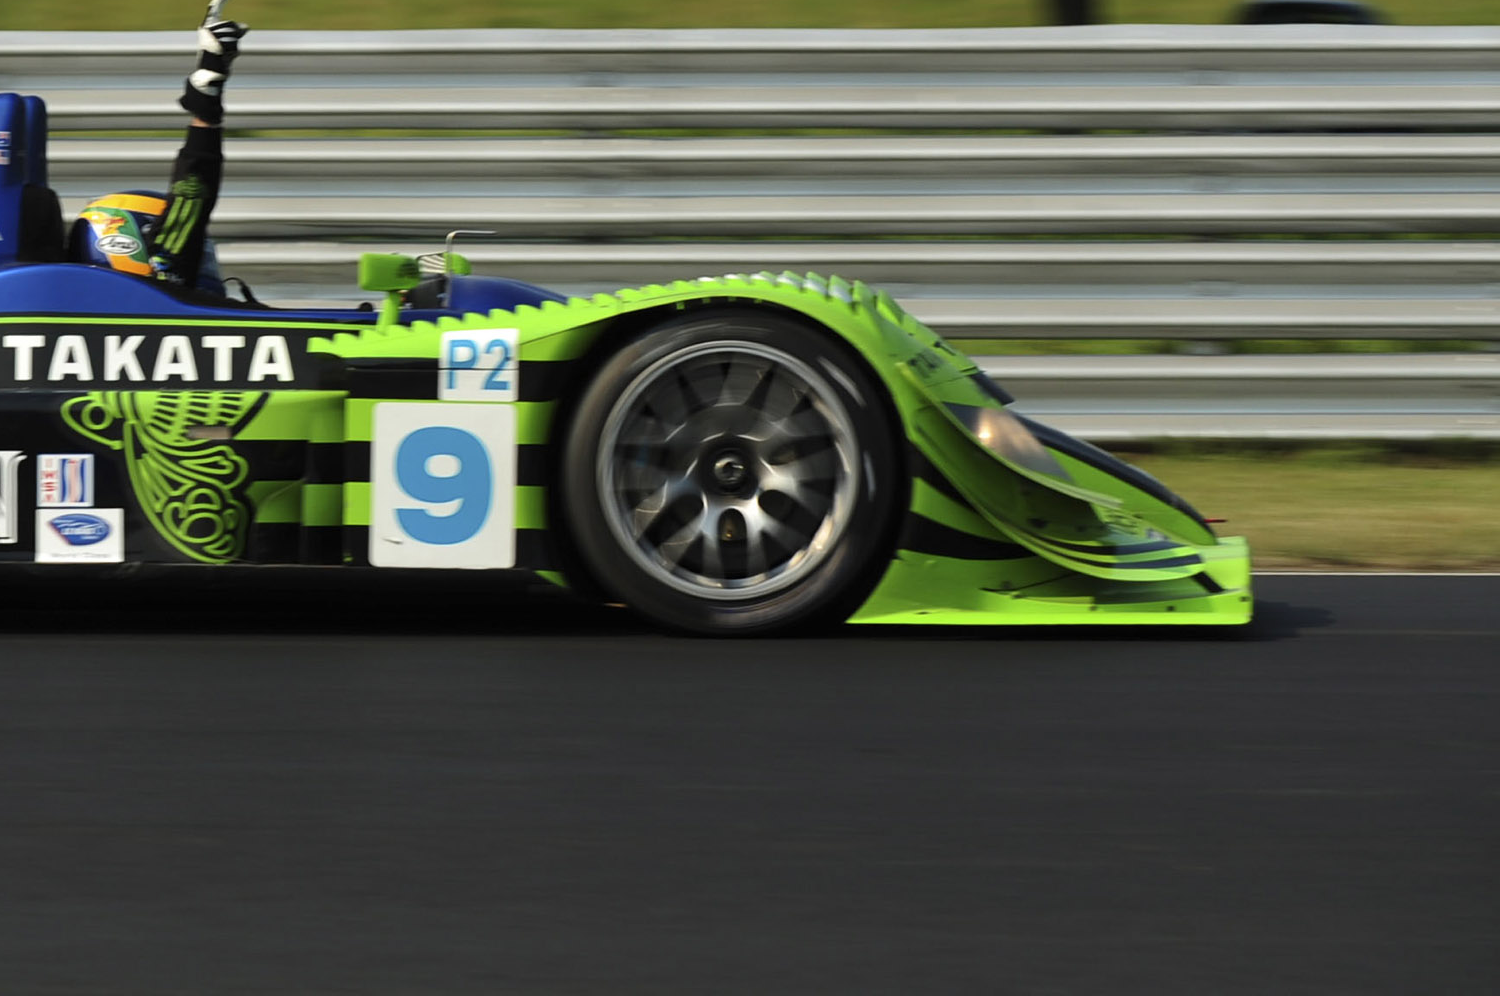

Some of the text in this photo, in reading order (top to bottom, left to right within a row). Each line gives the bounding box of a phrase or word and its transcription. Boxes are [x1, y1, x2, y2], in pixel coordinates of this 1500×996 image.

[2, 335, 295, 382] TAKATA
[446, 339, 512, 391] P2
[393, 426, 494, 545] 9
